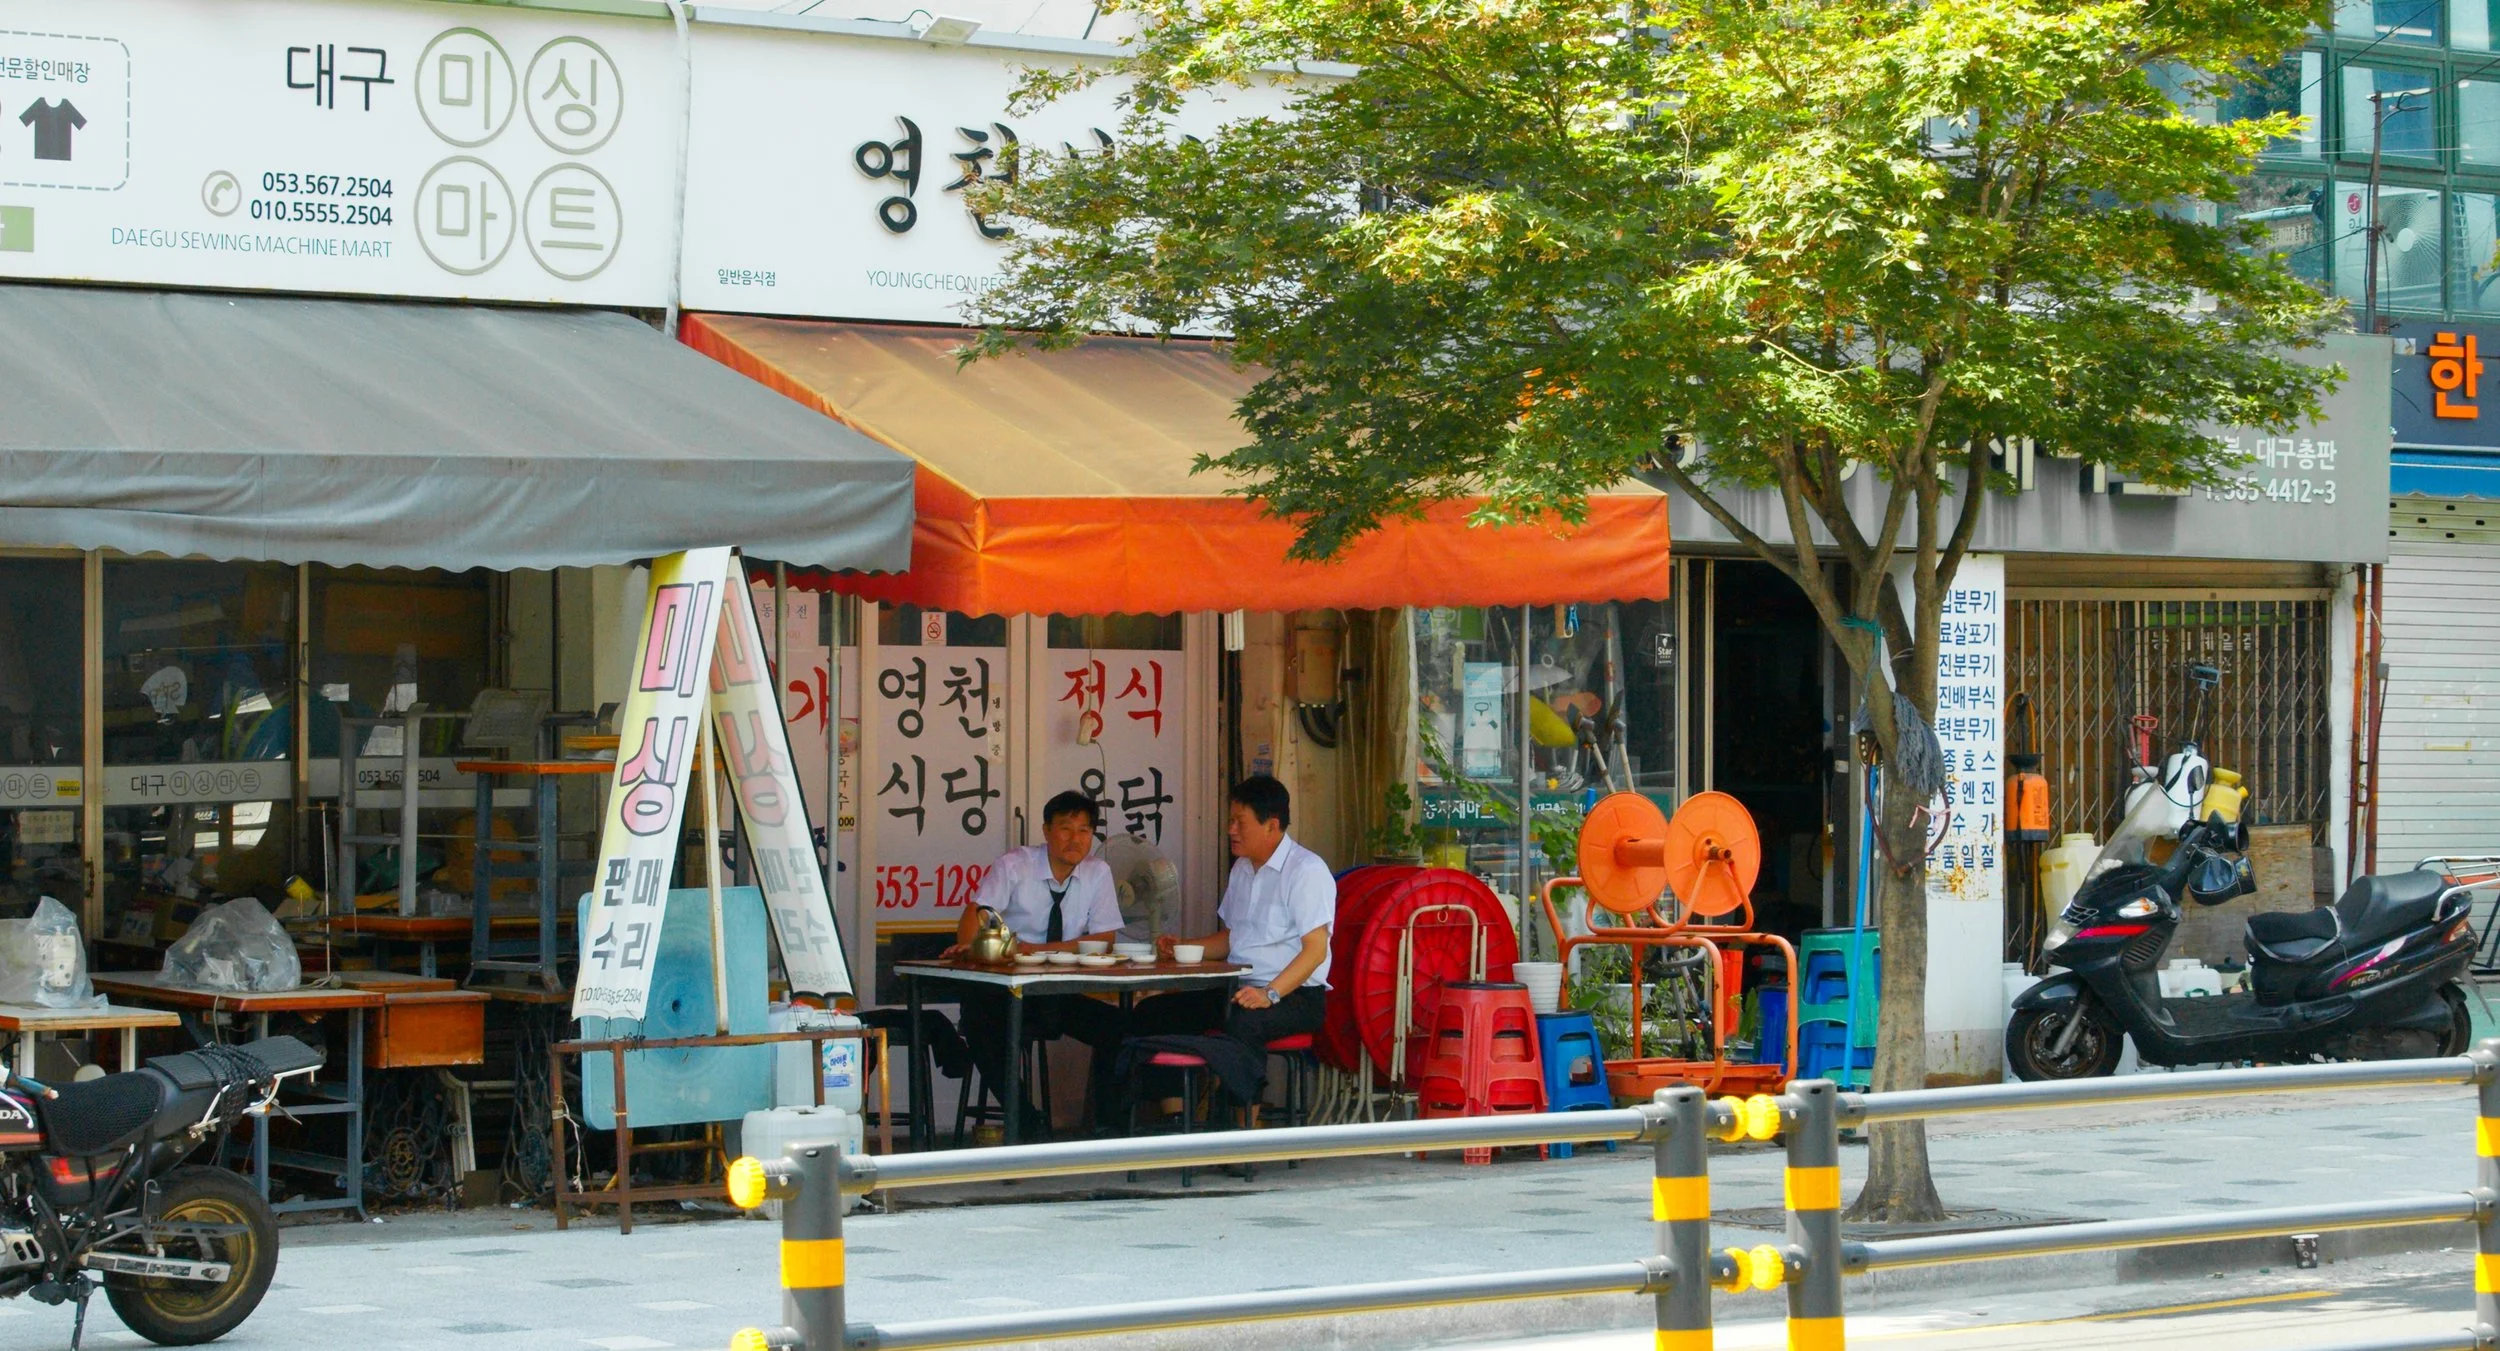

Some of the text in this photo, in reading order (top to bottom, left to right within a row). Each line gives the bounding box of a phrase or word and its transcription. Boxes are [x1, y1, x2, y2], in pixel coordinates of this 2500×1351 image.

[286, 43, 396, 112] 대구
[262, 171, 394, 198] 053.567.2504
[250, 199, 394, 226] 010.5555.2504
[111, 226, 393, 258] DAEGU SEWING MACHINE MART
[717, 268, 777, 288] 일반음식점
[865, 269, 978, 293] YOUNGCHEON
[2428, 331, 2484, 419] 한
[619, 580, 715, 837] 미싱
[877, 656, 990, 739] 영천
[1057, 659, 1163, 739] 정식
[1934, 716, 1996, 742] 력분무기
[130, 774, 168, 798] 대구
[876, 754, 1001, 837] 식당
[603, 856, 664, 908] 판매
[876, 863, 992, 909] 53-128
[591, 920, 653, 971] 수리
